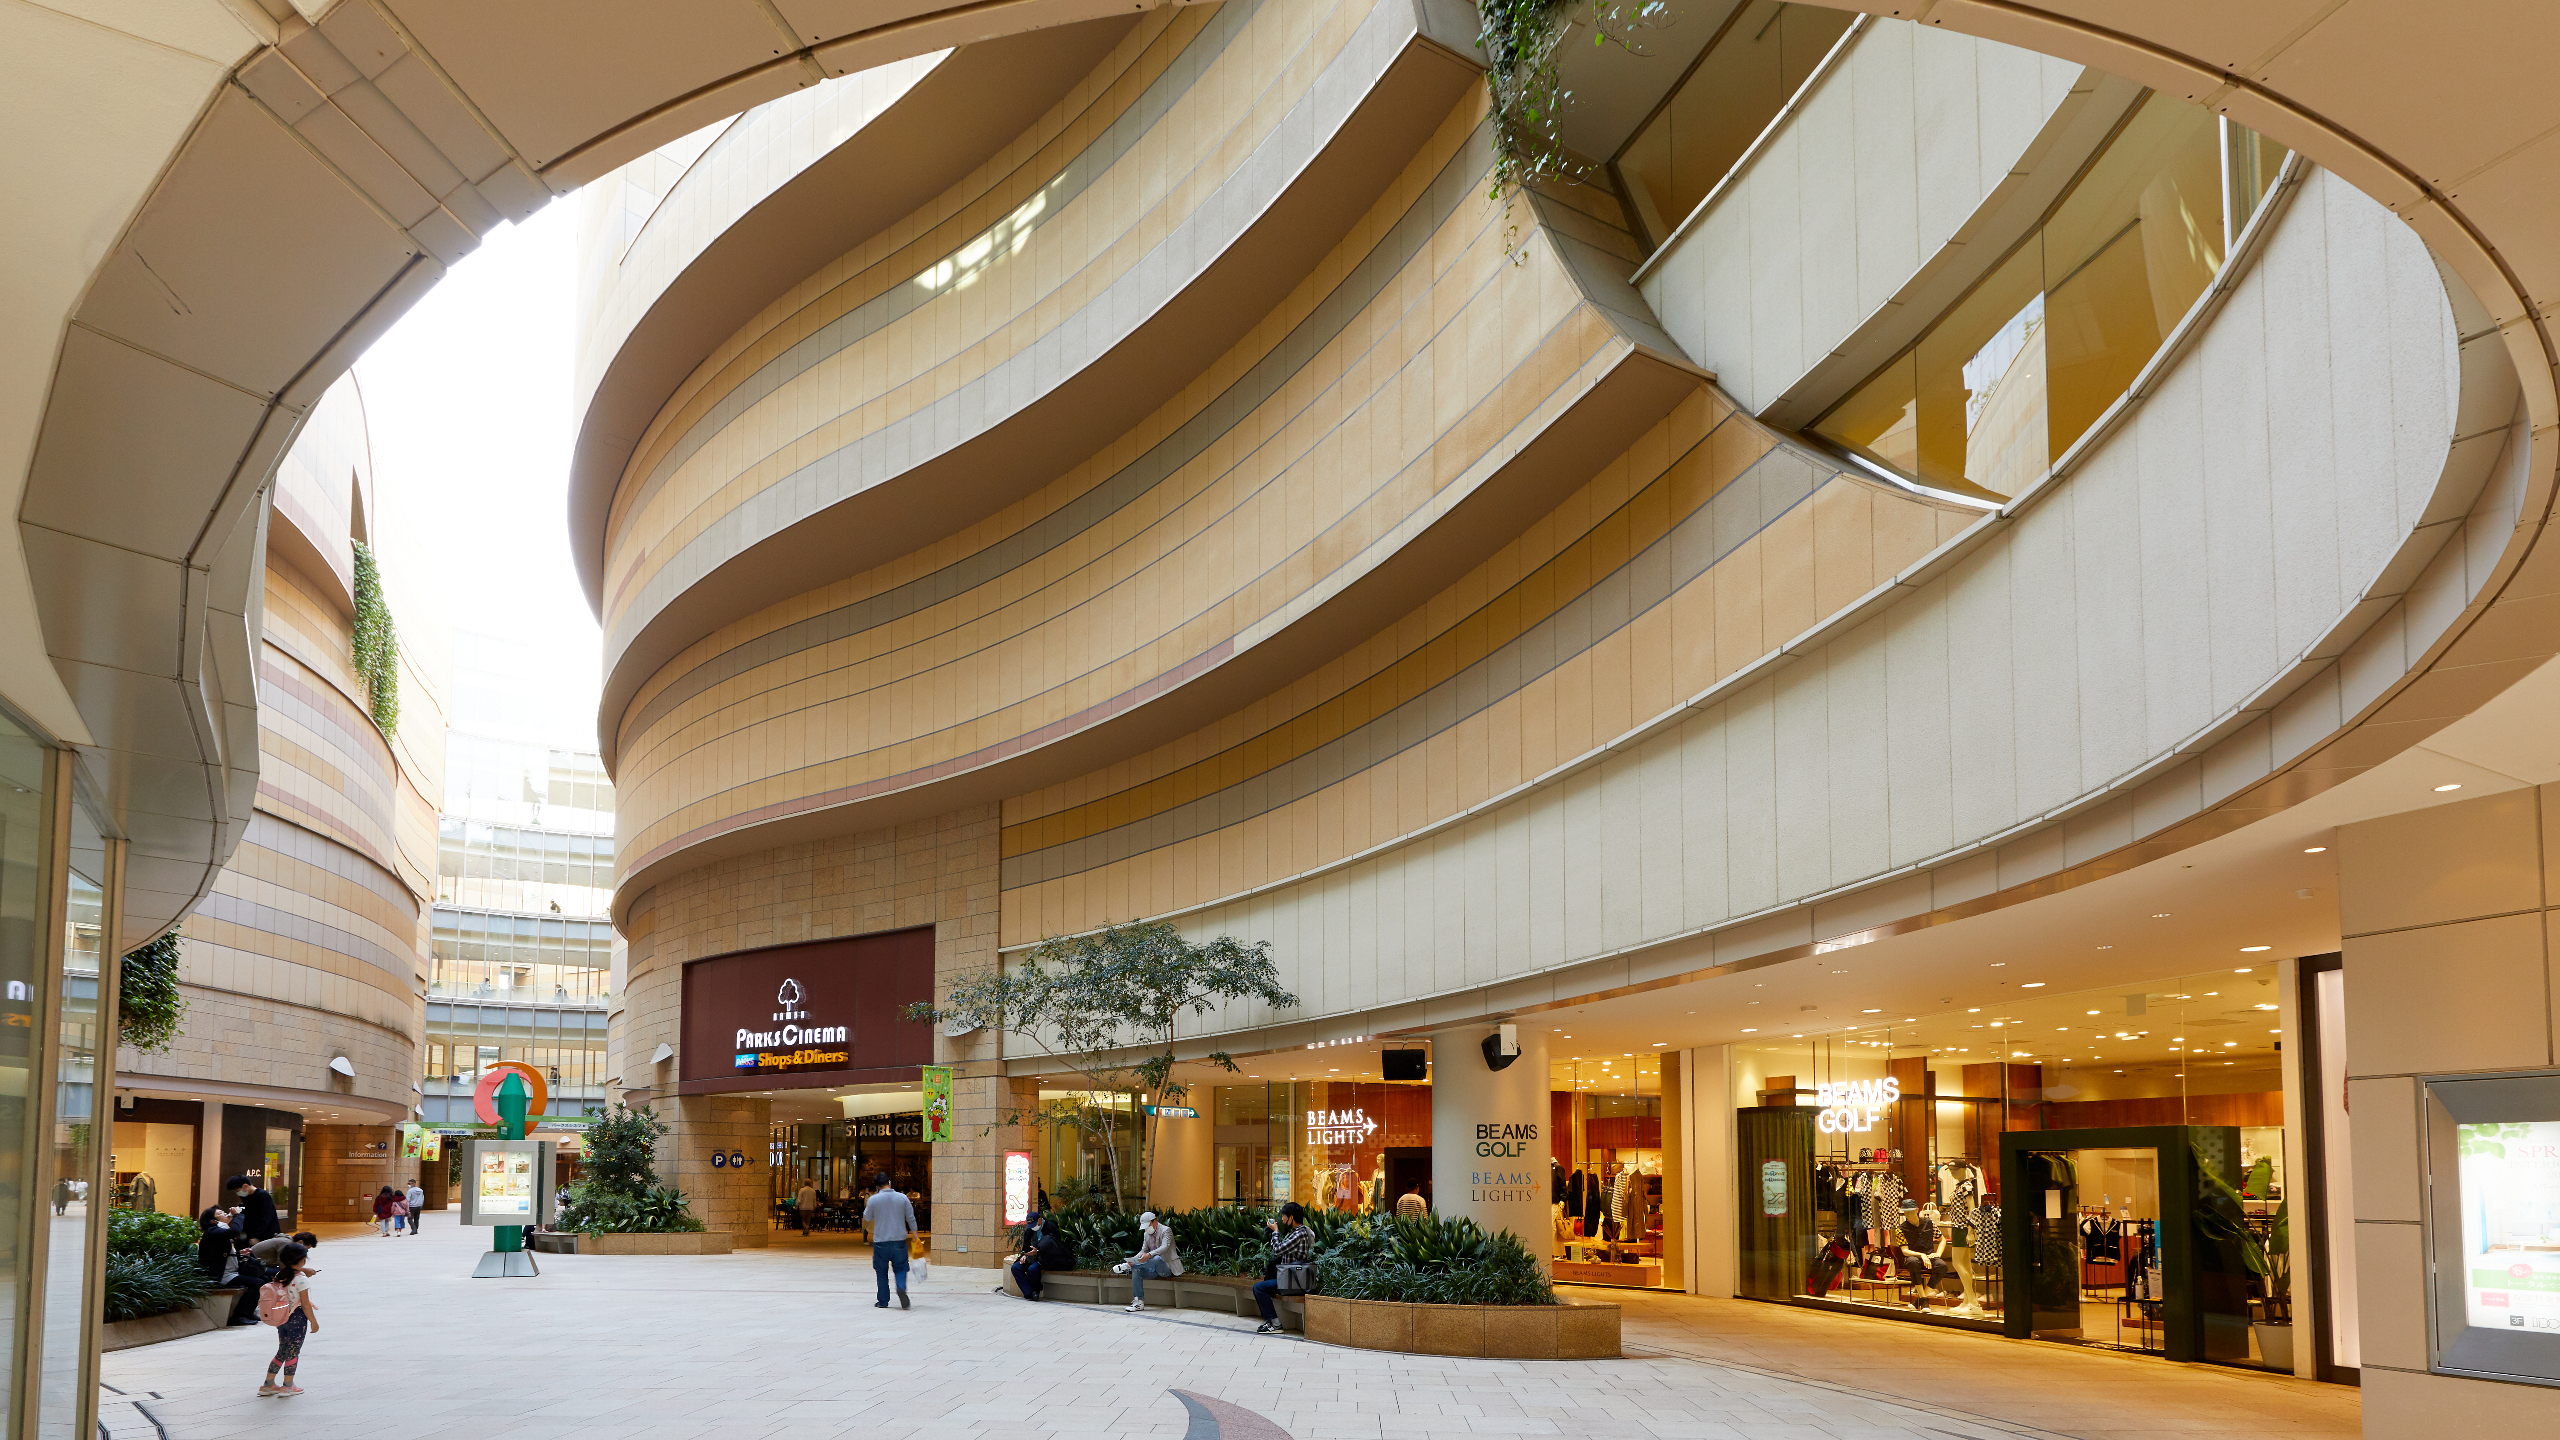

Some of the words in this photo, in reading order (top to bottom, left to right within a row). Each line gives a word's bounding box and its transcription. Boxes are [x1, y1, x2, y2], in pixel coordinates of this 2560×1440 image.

[1819, 1077, 1900, 1107] BEAMS
[1307, 1109, 1364, 1126] BEAMS
[1818, 1107, 1881, 1133] GOLF
[846, 1123, 920, 1137] STARBUCKS
[1307, 1130, 1364, 1145] LIGHTS
[1476, 1124, 1538, 1140] BEAMS
[1476, 1141, 1527, 1158] GOLF
[246, 1168, 262, 1177] A.P.C.
[1471, 1172, 1532, 1185] BEAMS
[1471, 1189, 1532, 1202] LIGHTS
[2511, 1316, 2523, 1325] 3F
